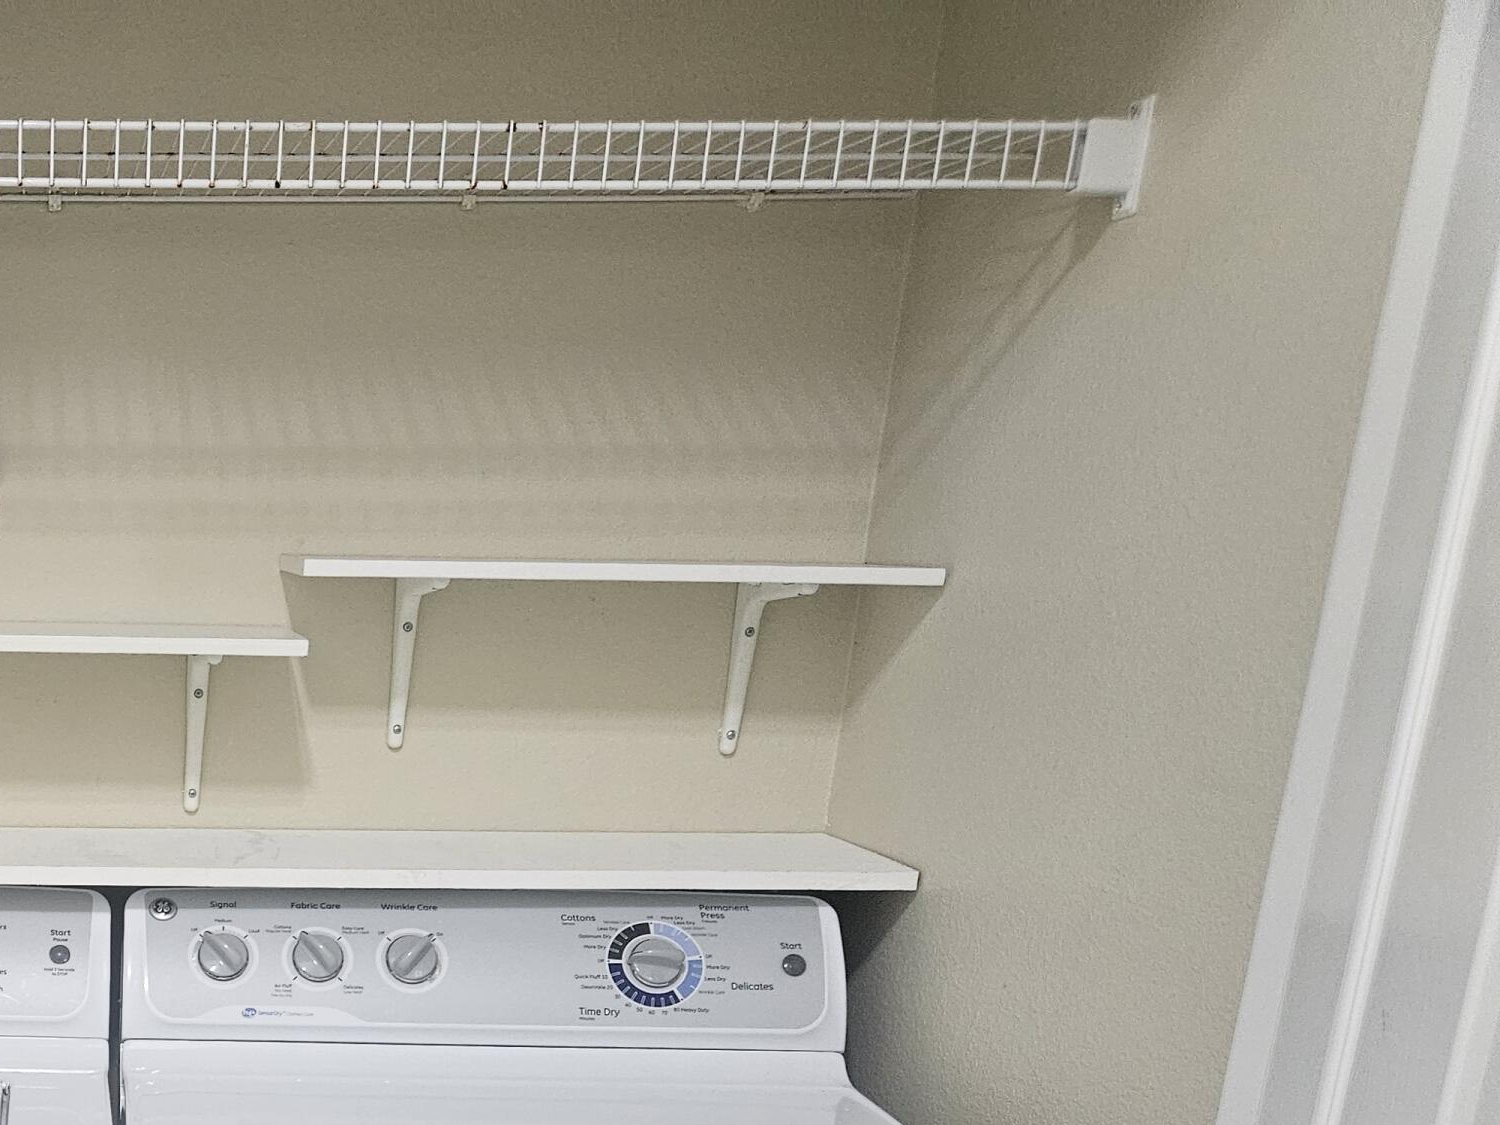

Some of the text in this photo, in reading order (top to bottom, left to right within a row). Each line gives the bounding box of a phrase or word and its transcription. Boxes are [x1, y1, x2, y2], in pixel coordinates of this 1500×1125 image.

[209, 901, 237, 909] Signal
[381, 903, 416, 911] Wrinkle
[699, 904, 749, 912] Permanent
[780, 942, 802, 950] Start
[731, 982, 774, 991] Delicates
[579, 1007, 620, 1017] Time Dry
